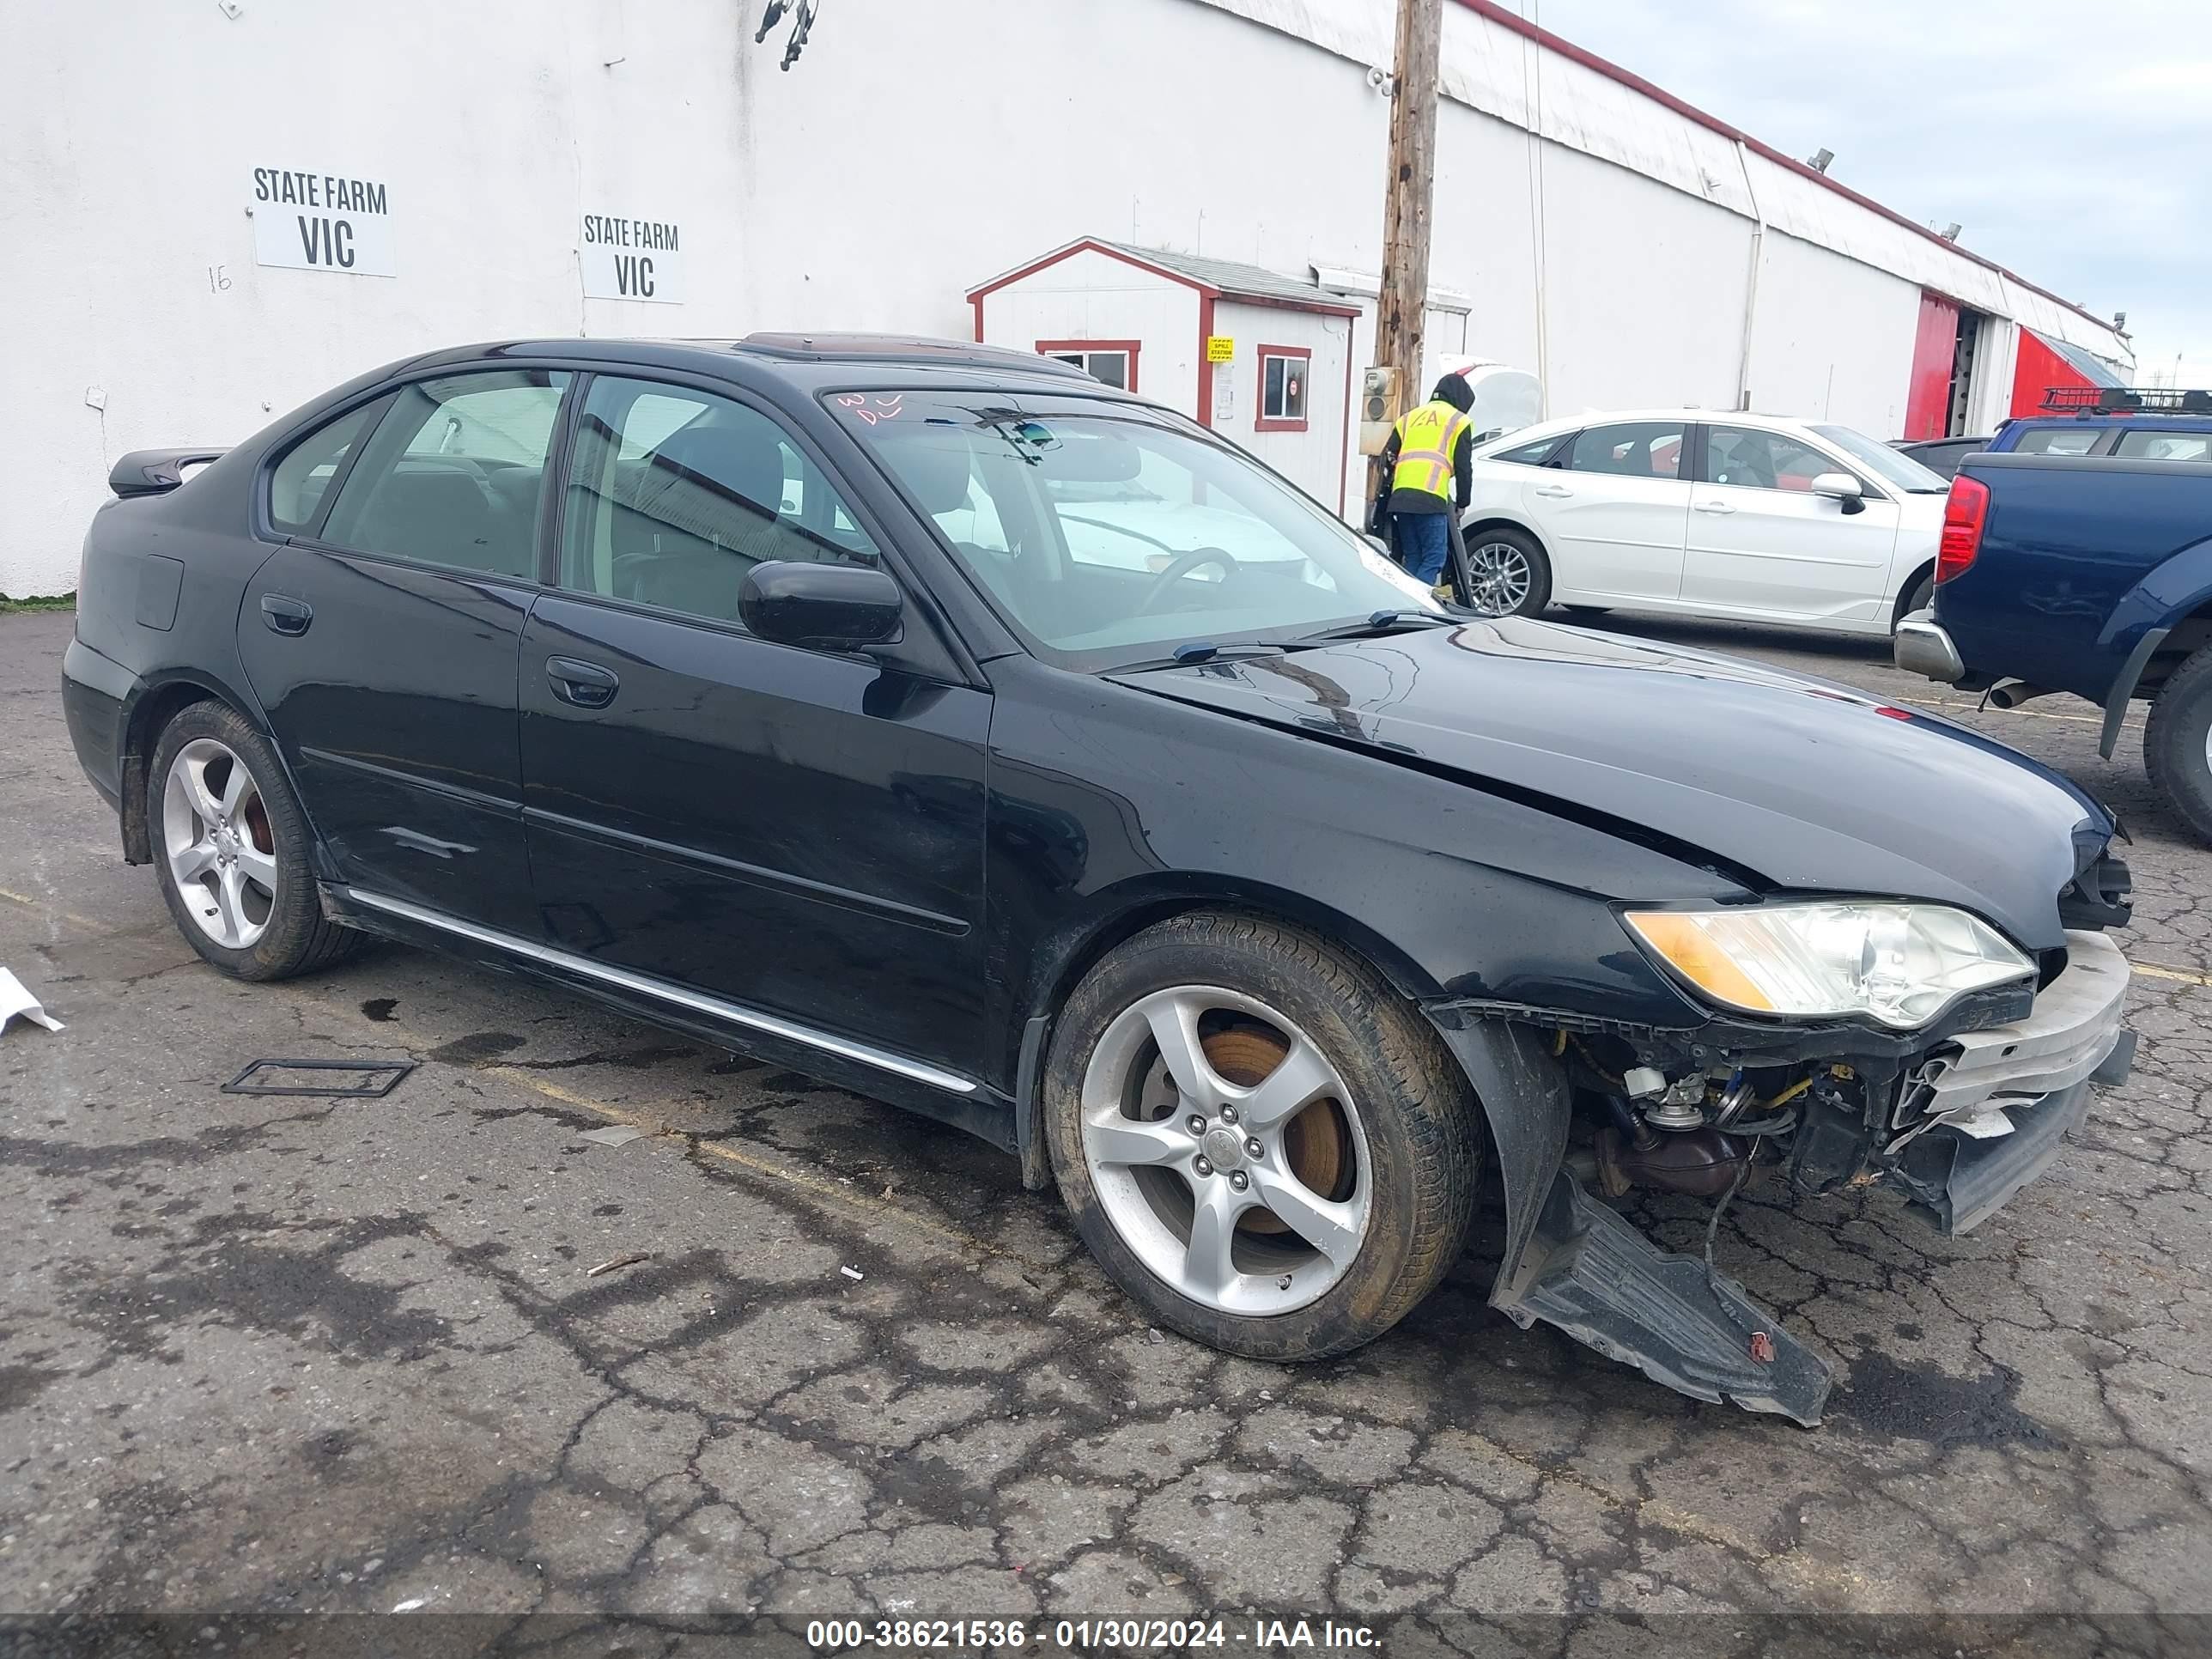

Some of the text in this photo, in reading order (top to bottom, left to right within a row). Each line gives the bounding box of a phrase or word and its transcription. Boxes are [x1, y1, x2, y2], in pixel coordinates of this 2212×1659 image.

[254, 167, 387, 216] STATE FARM
[297, 215, 355, 268] VIC
[584, 214, 679, 252] STATE FARM
[208, 264, 232, 295] 16
[614, 253, 654, 298] VIC
